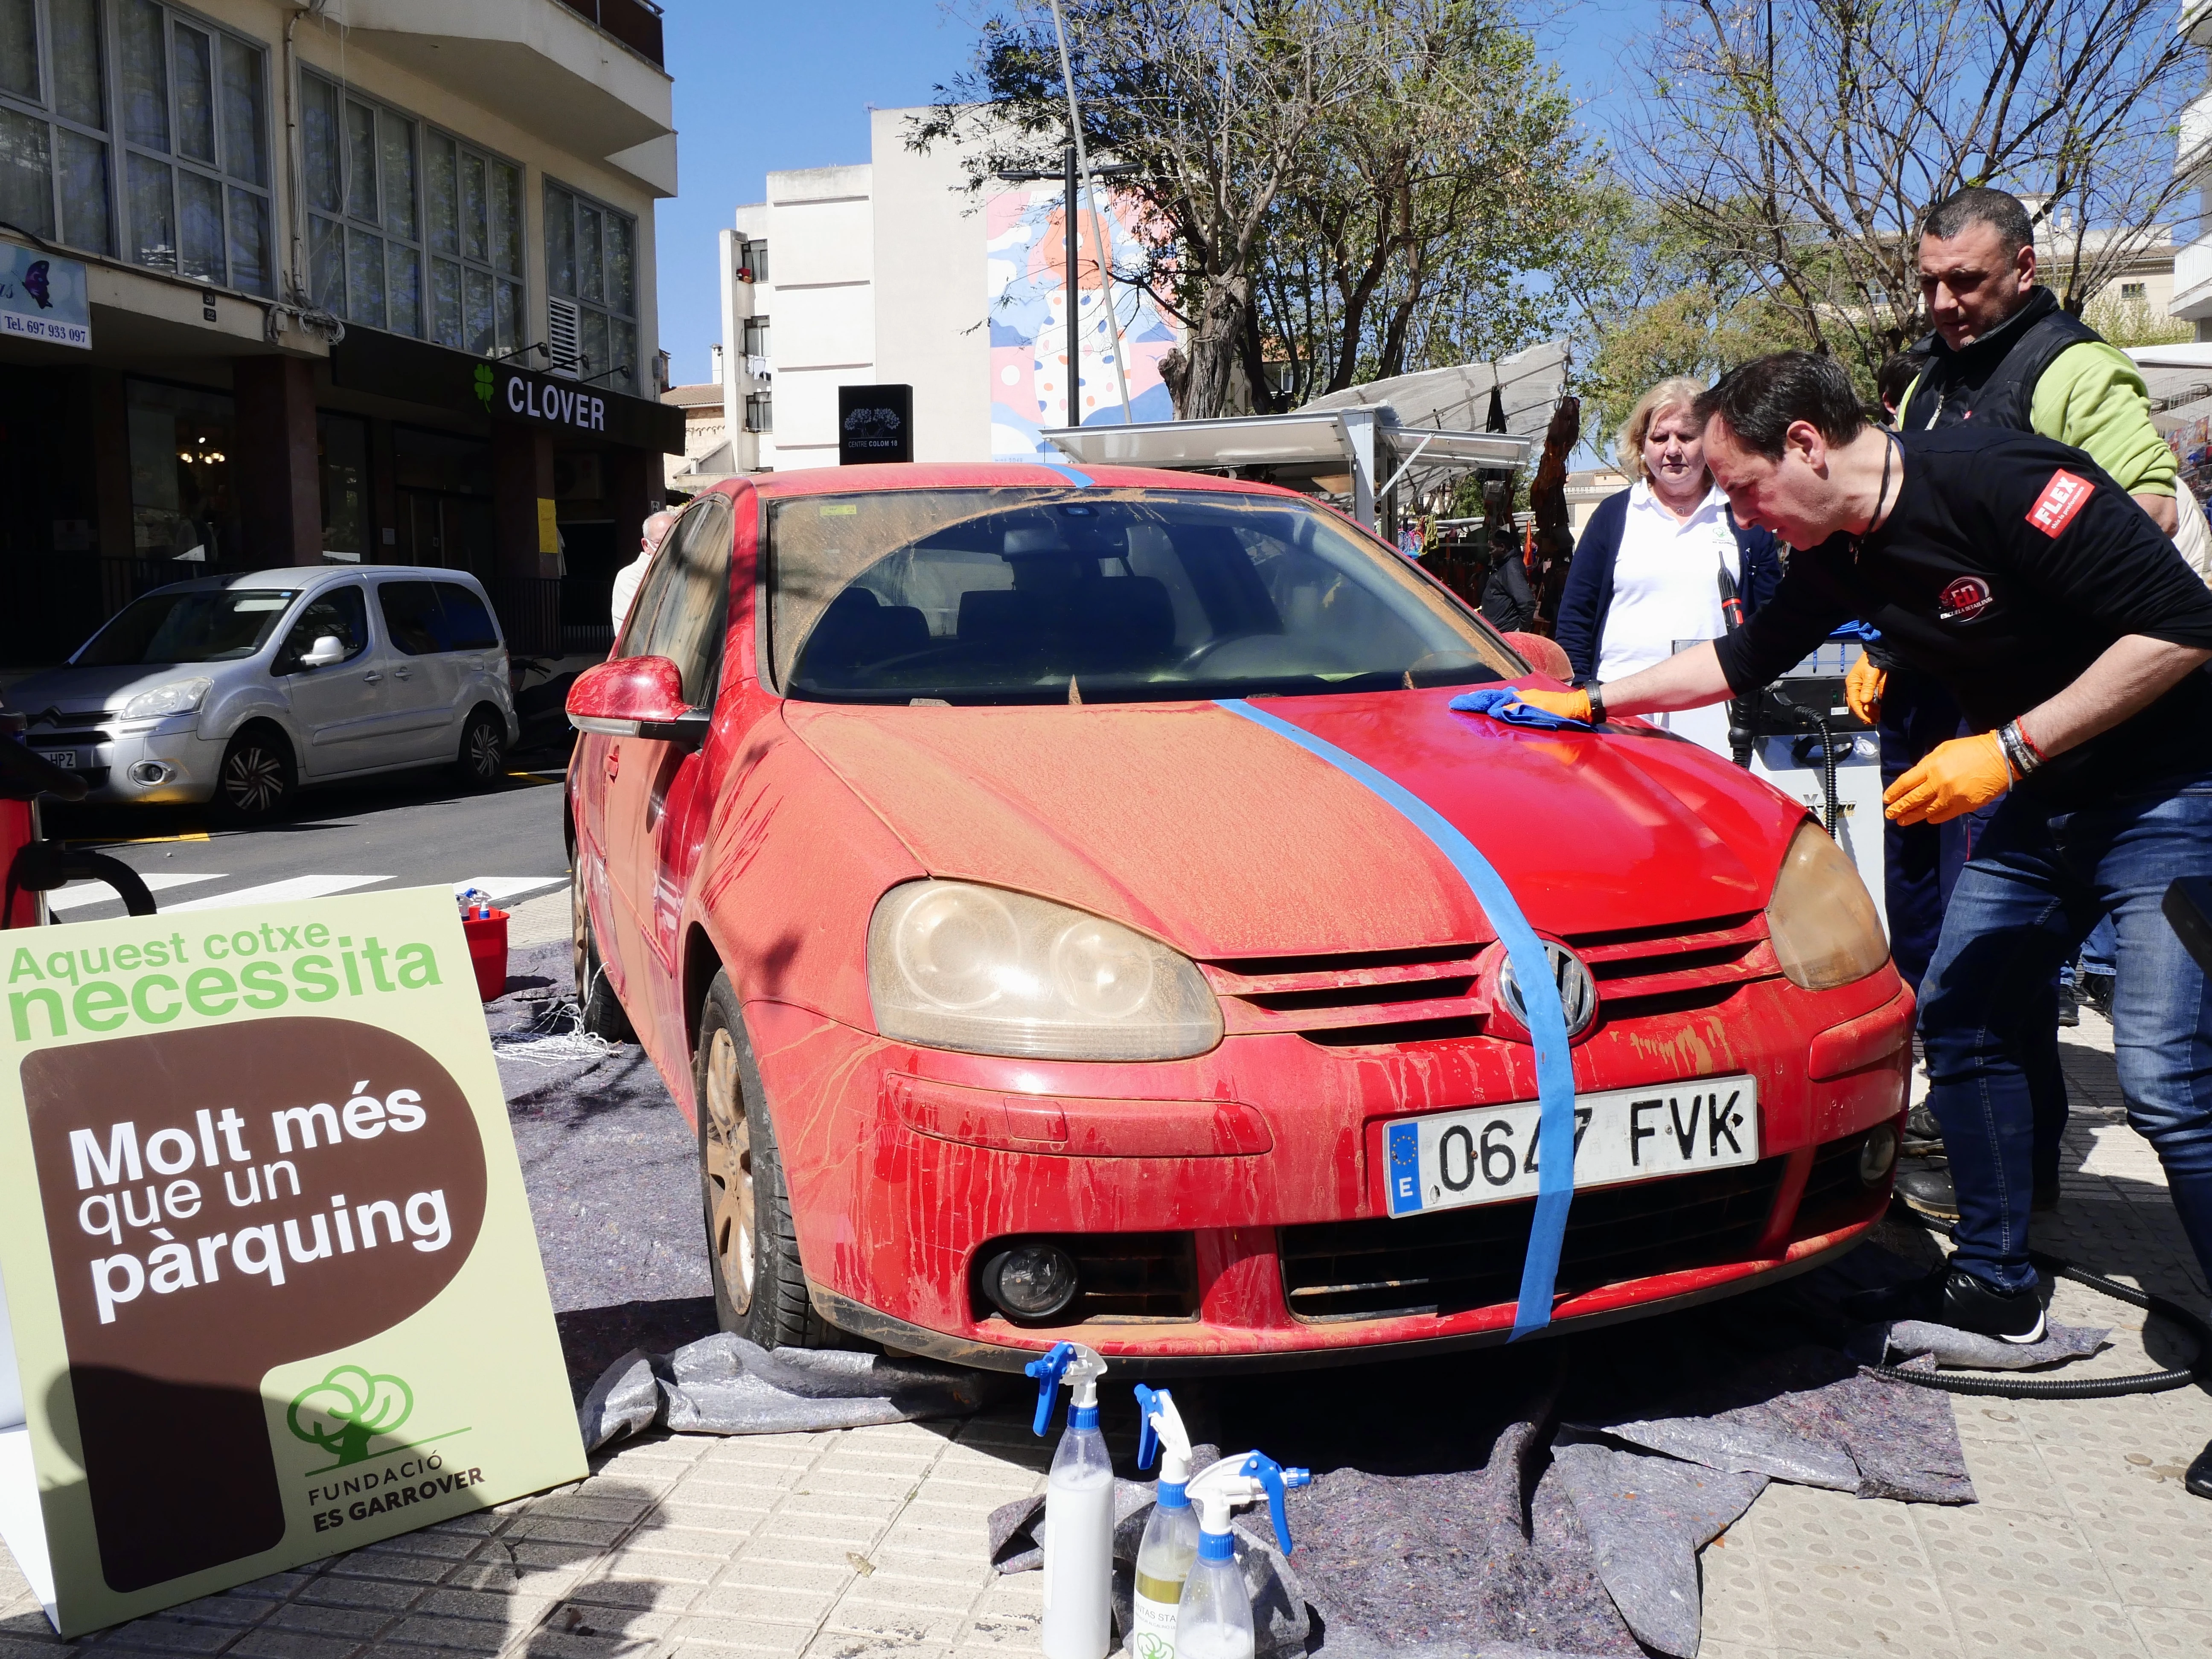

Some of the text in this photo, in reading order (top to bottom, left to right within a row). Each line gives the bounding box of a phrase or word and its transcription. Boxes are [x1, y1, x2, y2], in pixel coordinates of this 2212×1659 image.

[206, 294, 213, 303] 20
[207, 311, 215, 319] 22
[5, 316, 86, 343] Tel. 697 933 097
[507, 376, 605, 431] CLOVER
[2034, 476, 2078, 525] FLEX
[2051, 518, 2061, 529] this
[2063, 486, 2085, 515] proformance
[1940, 596, 1994, 619] ESCUELA DETAILING
[1950, 584, 1979, 608] ED
[8, 922, 330, 987] Aquest cotxe
[9, 936, 443, 1042] necessita
[68, 1080, 427, 1190] Molt més
[1630, 1090, 1742, 1166] FVK
[79, 1160, 301, 1246] que un
[1398, 1178, 1414, 1197] E
[90, 1189, 452, 1325] pàrquing
[308, 1449, 443, 1507] FUNDACIÓ
[313, 1466, 486, 1533] ES GARROVER
[1149, 1621, 1170, 1630] ALCALINO
